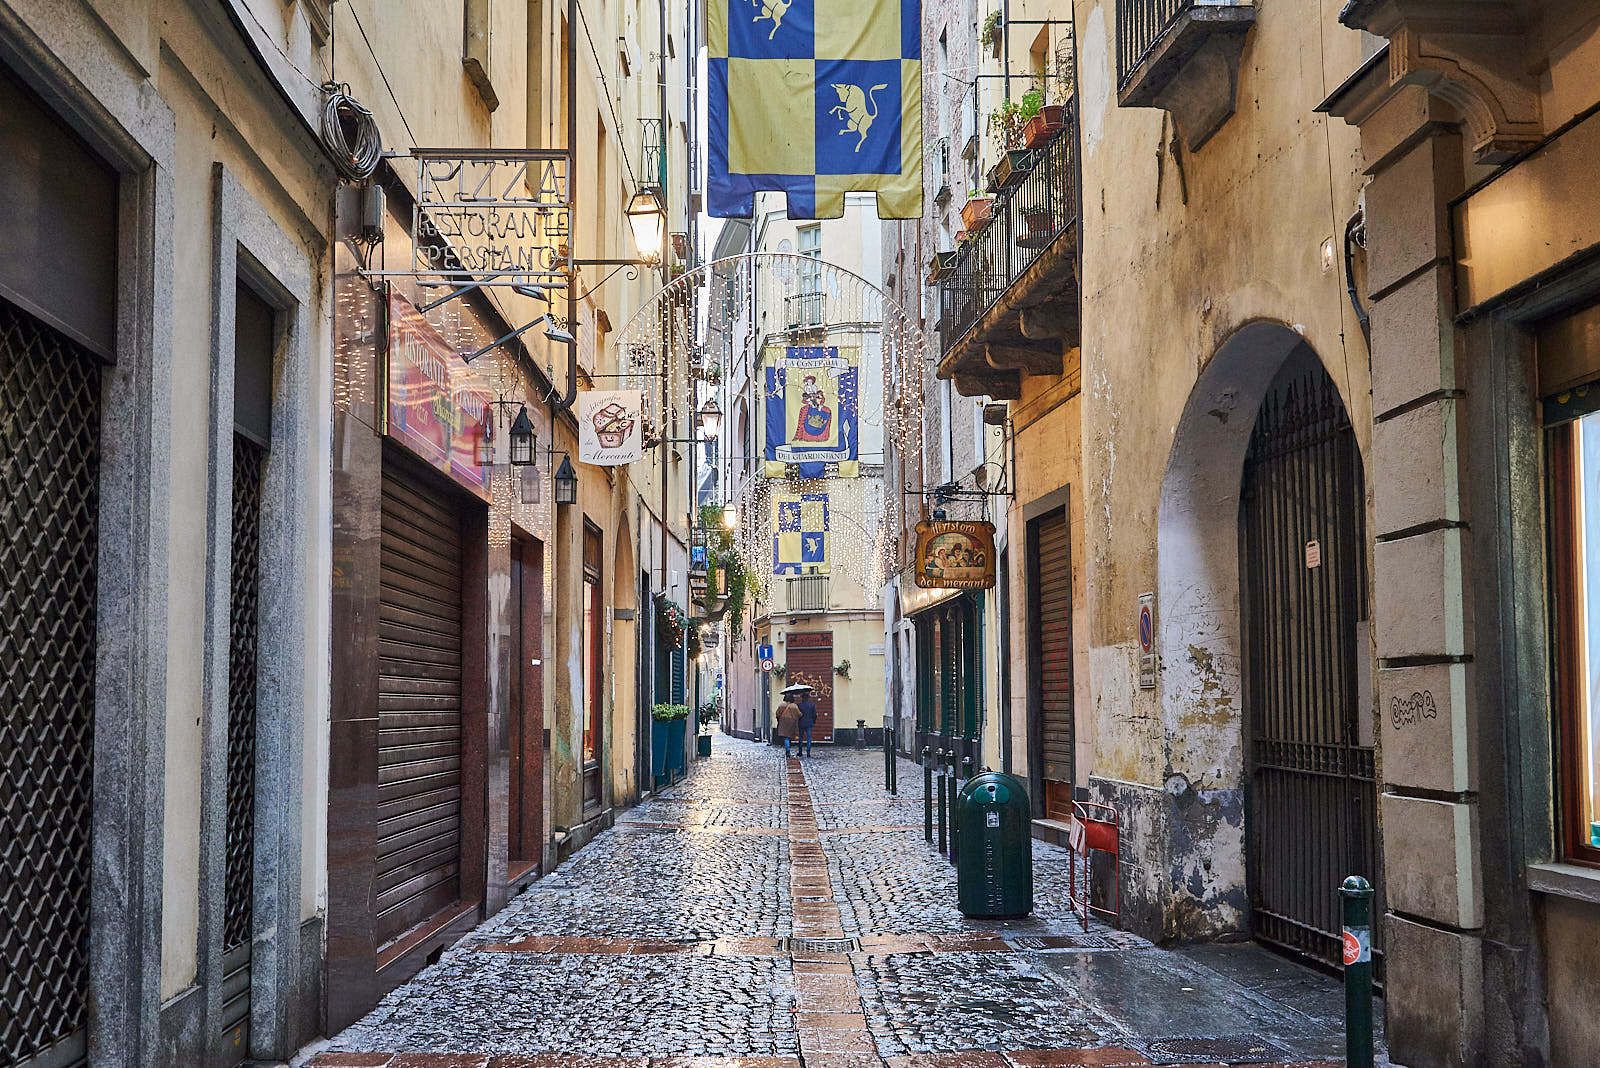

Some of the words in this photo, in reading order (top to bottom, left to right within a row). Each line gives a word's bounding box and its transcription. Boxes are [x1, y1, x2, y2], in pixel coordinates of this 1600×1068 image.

[425, 159, 564, 202] PIZZA
[418, 211, 569, 239] RISTORANTE
[426, 244, 558, 271] PERSIANO
[404, 329, 446, 391] RISTORANTE
[583, 449, 636, 460] Mercanti
[778, 451, 790, 460] DEI
[792, 450, 848, 461] GUARDINFANTI
[942, 521, 976, 535] ristoro
[920, 575, 937, 588] dei
[942, 578, 989, 589] mercanti
